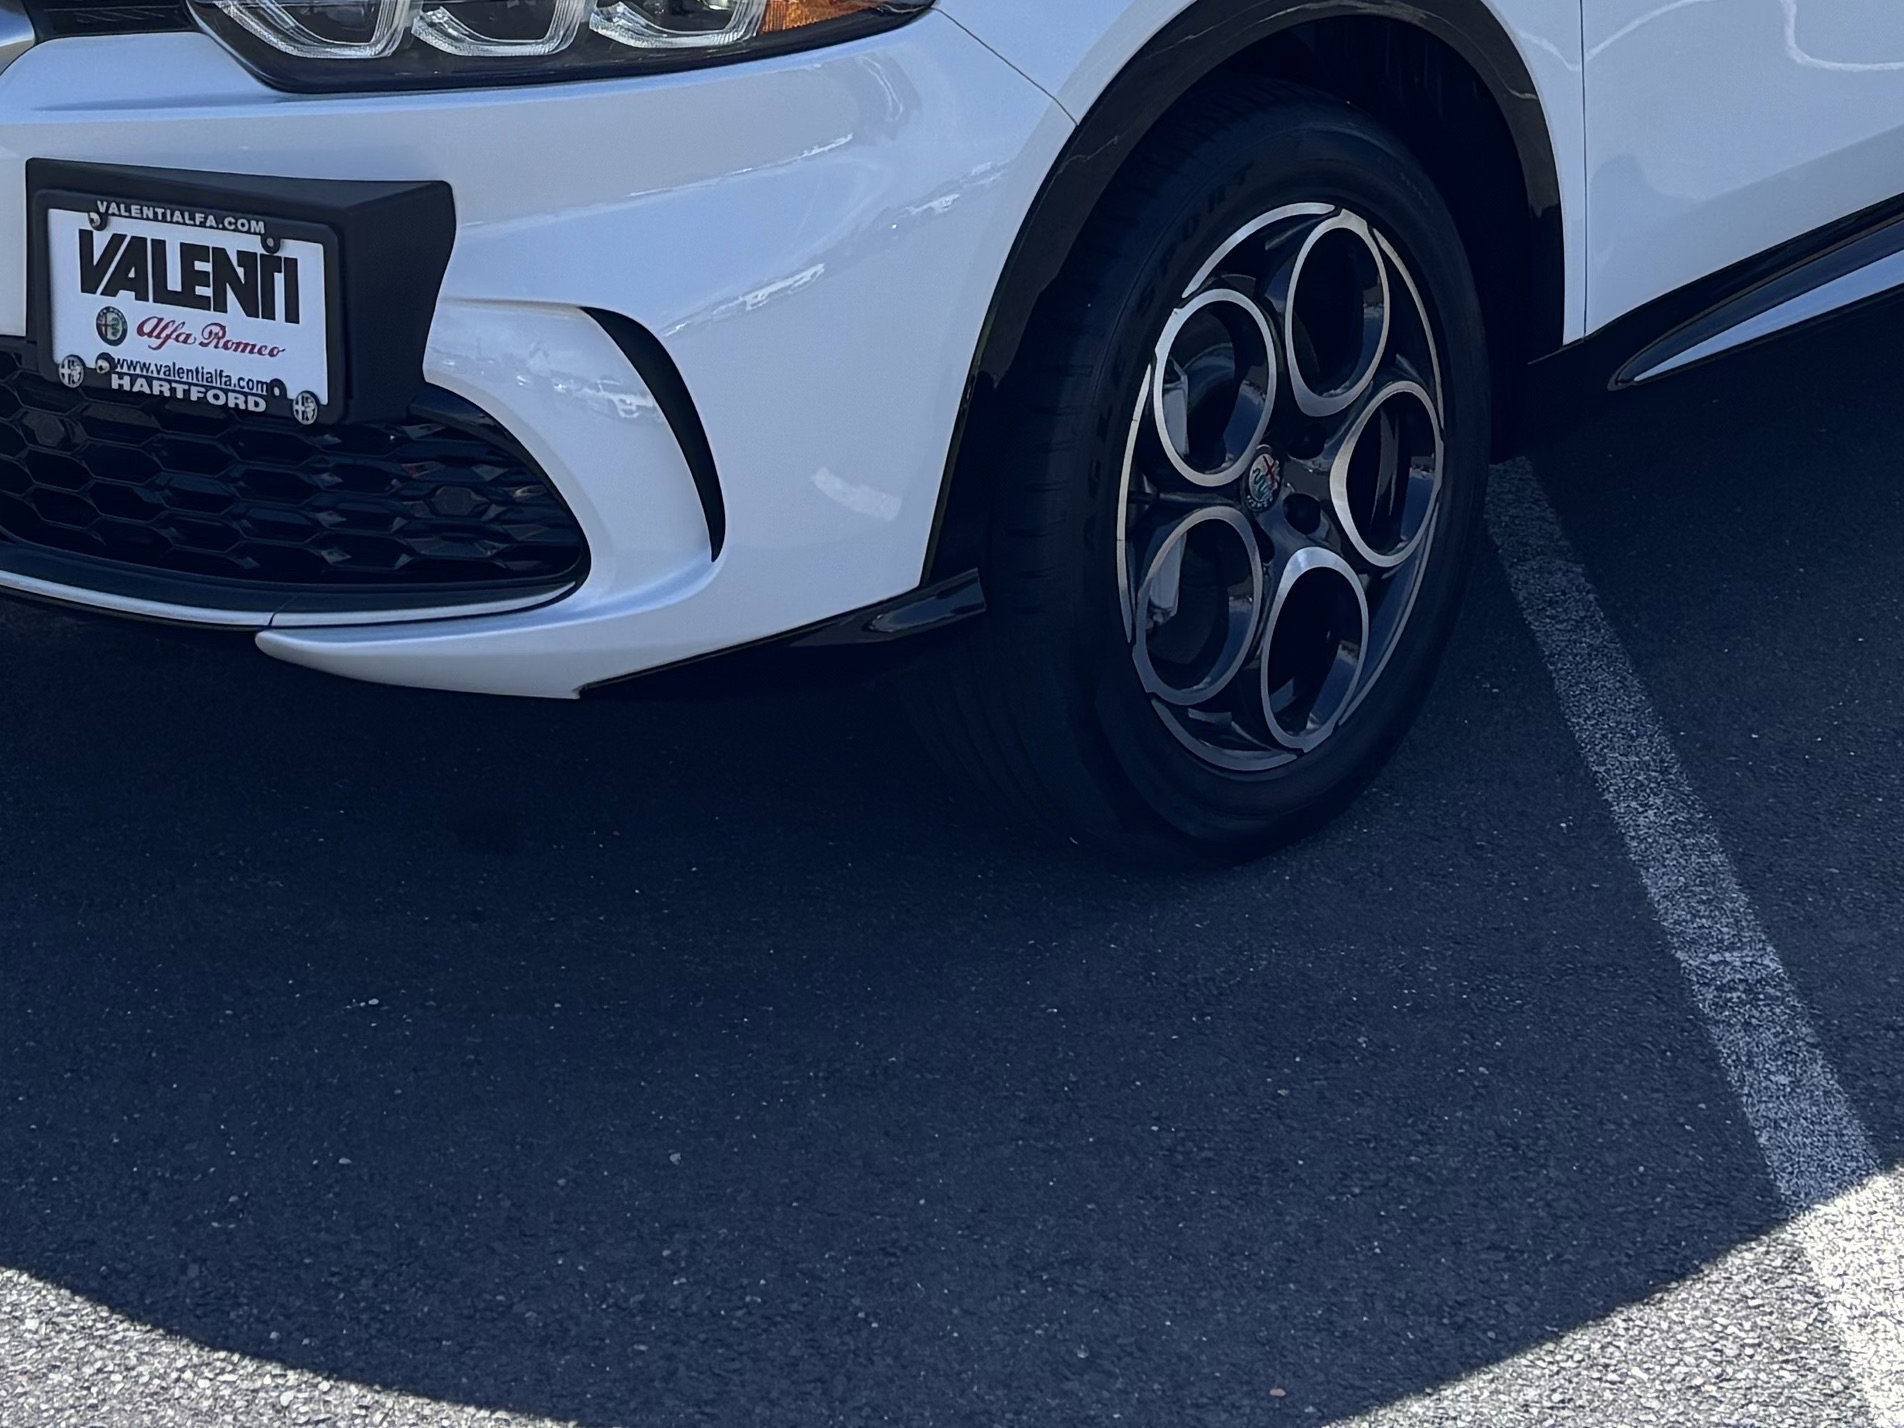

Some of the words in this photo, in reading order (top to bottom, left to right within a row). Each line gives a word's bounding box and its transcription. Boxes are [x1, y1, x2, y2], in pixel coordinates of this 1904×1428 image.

[96, 200, 265, 234] VALENTIALFA.COM
[78, 227, 300, 325] VALENTI
[136, 315, 197, 351] Alfa
[198, 322, 286, 358] Romeo
[111, 373, 267, 412] HARTFORD
[114, 356, 271, 395] www.valentialfa.com
